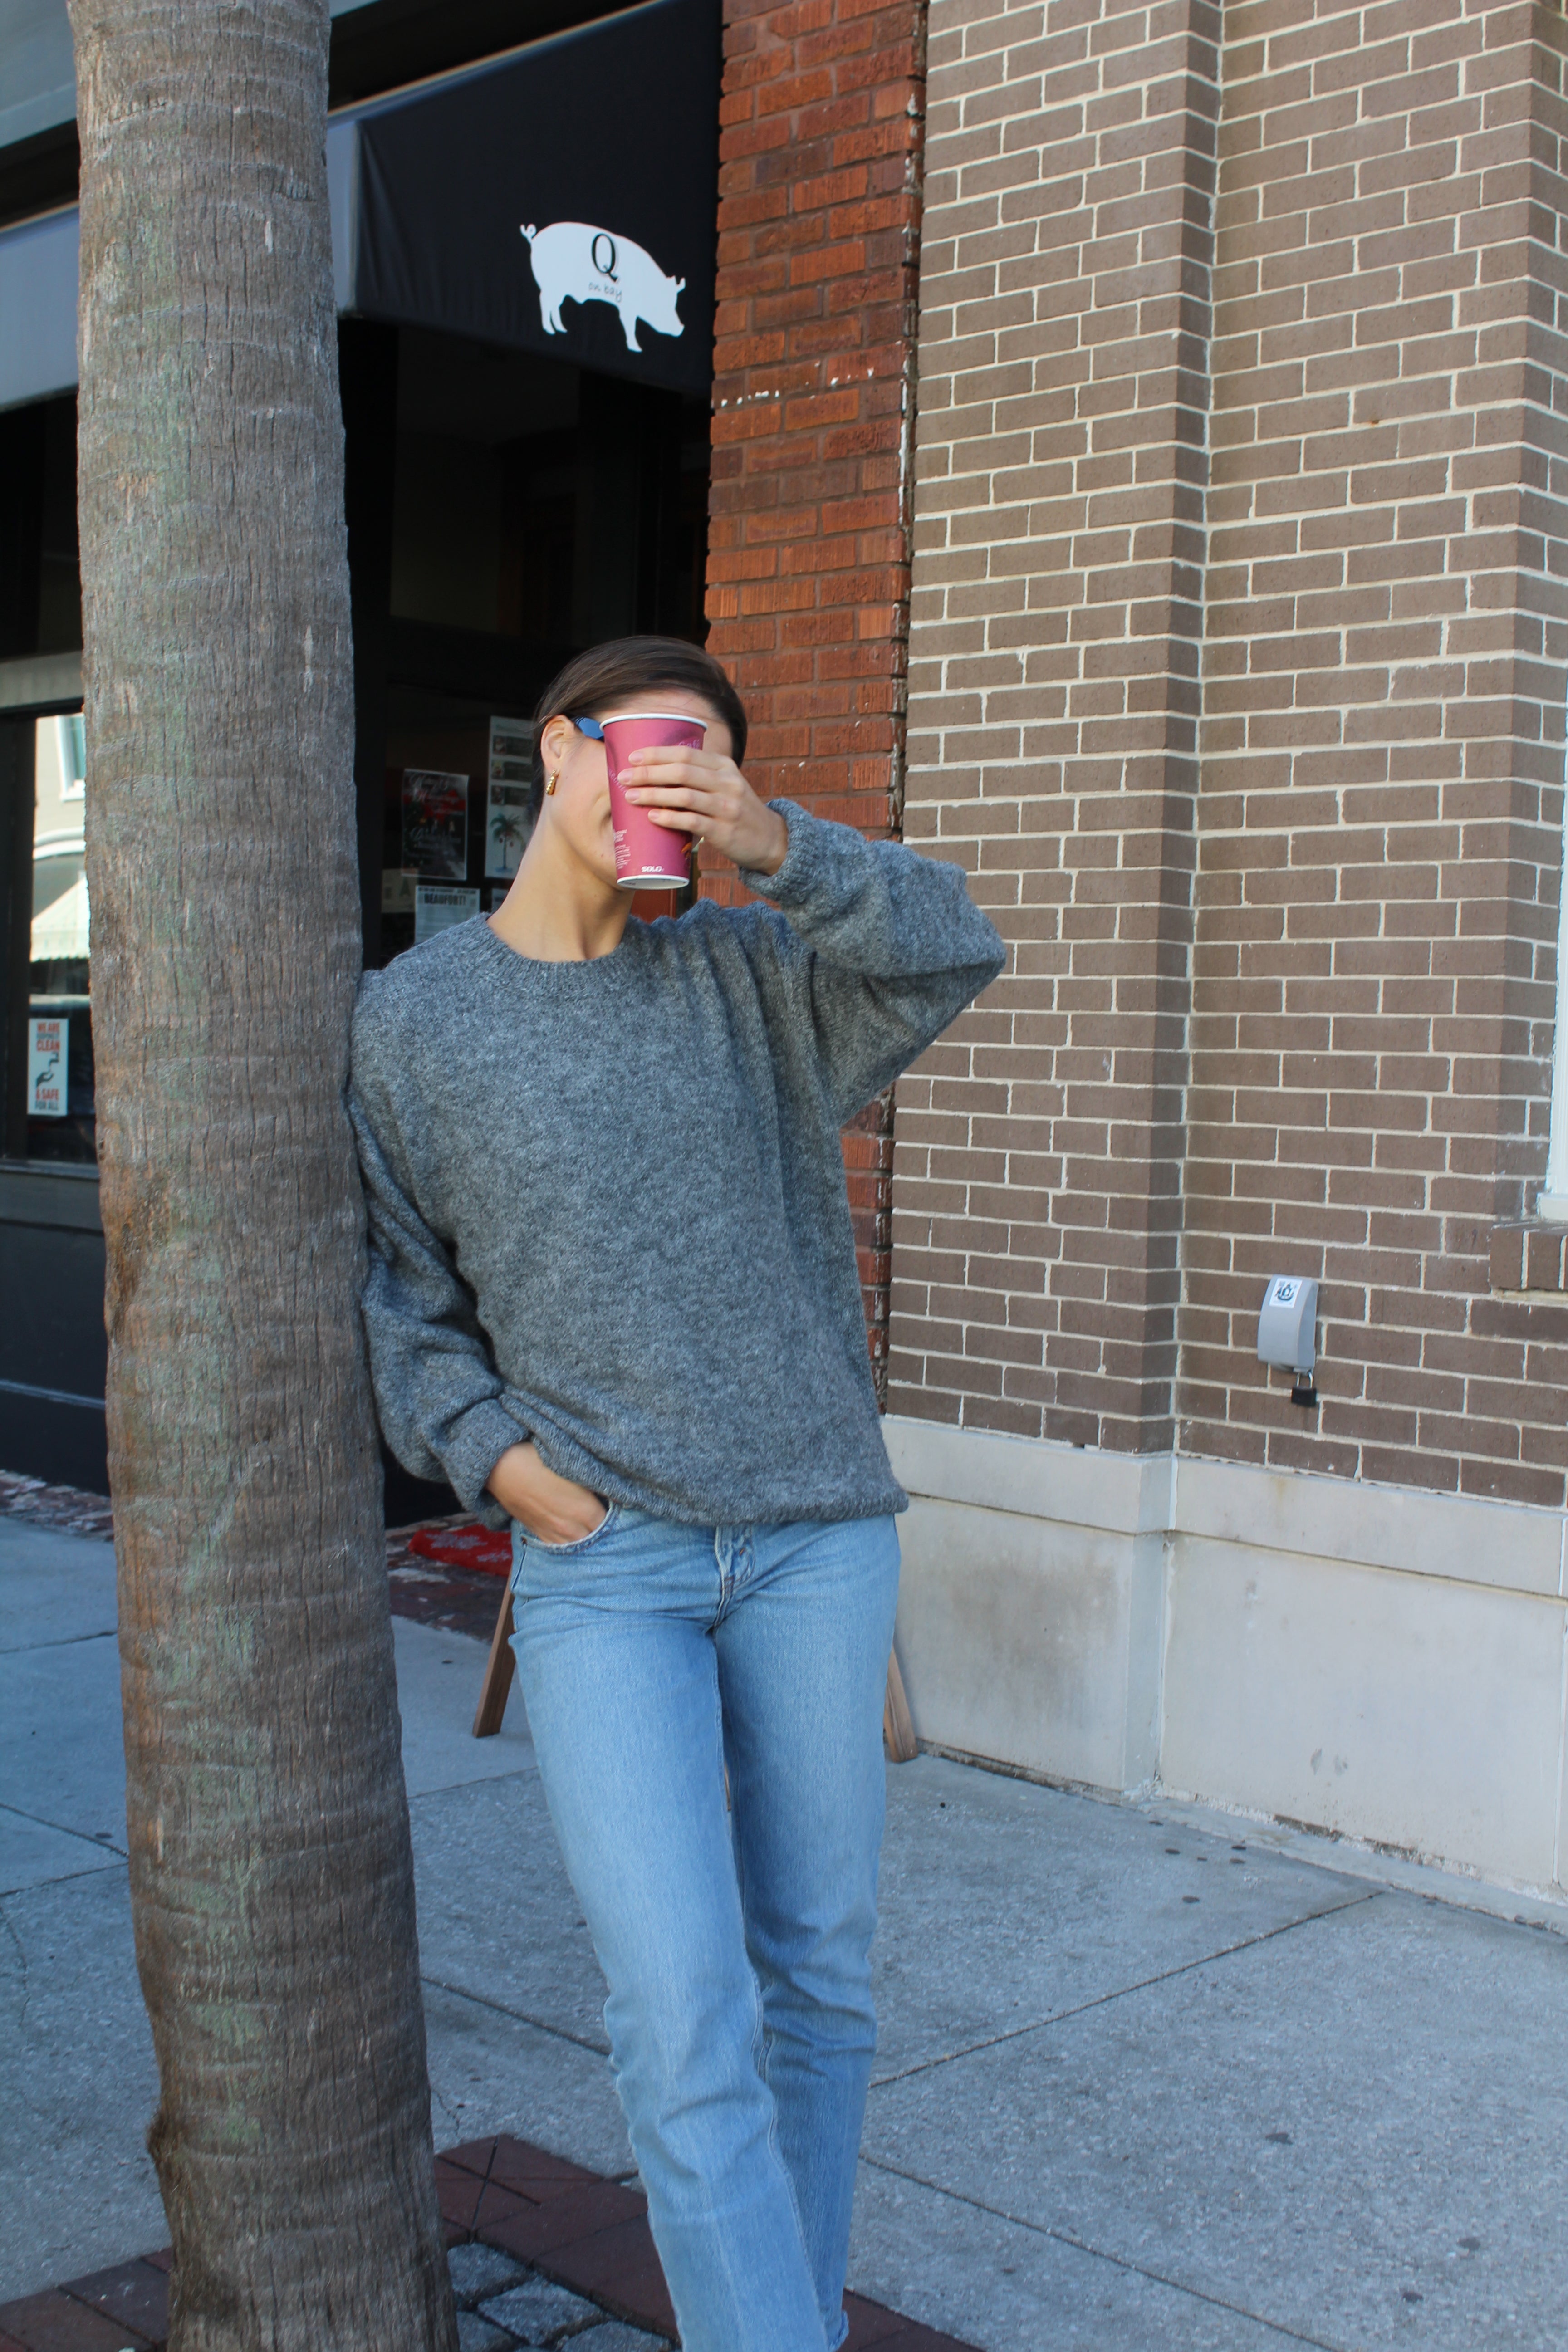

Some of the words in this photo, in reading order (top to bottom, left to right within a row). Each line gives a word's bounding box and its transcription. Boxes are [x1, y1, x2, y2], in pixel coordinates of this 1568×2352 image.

[591, 233, 619, 282] Q
[588, 282, 601, 294] on
[604, 283, 622, 303] bay
[37, 1023, 46, 1033] WE
[48, 1023, 60, 1033] ARE
[37, 1039, 60, 1052] CLEAN
[42, 1088, 59, 1100] SAFE
[35, 1100, 46, 1110] FOR
[48, 1101, 59, 1111] ALL
